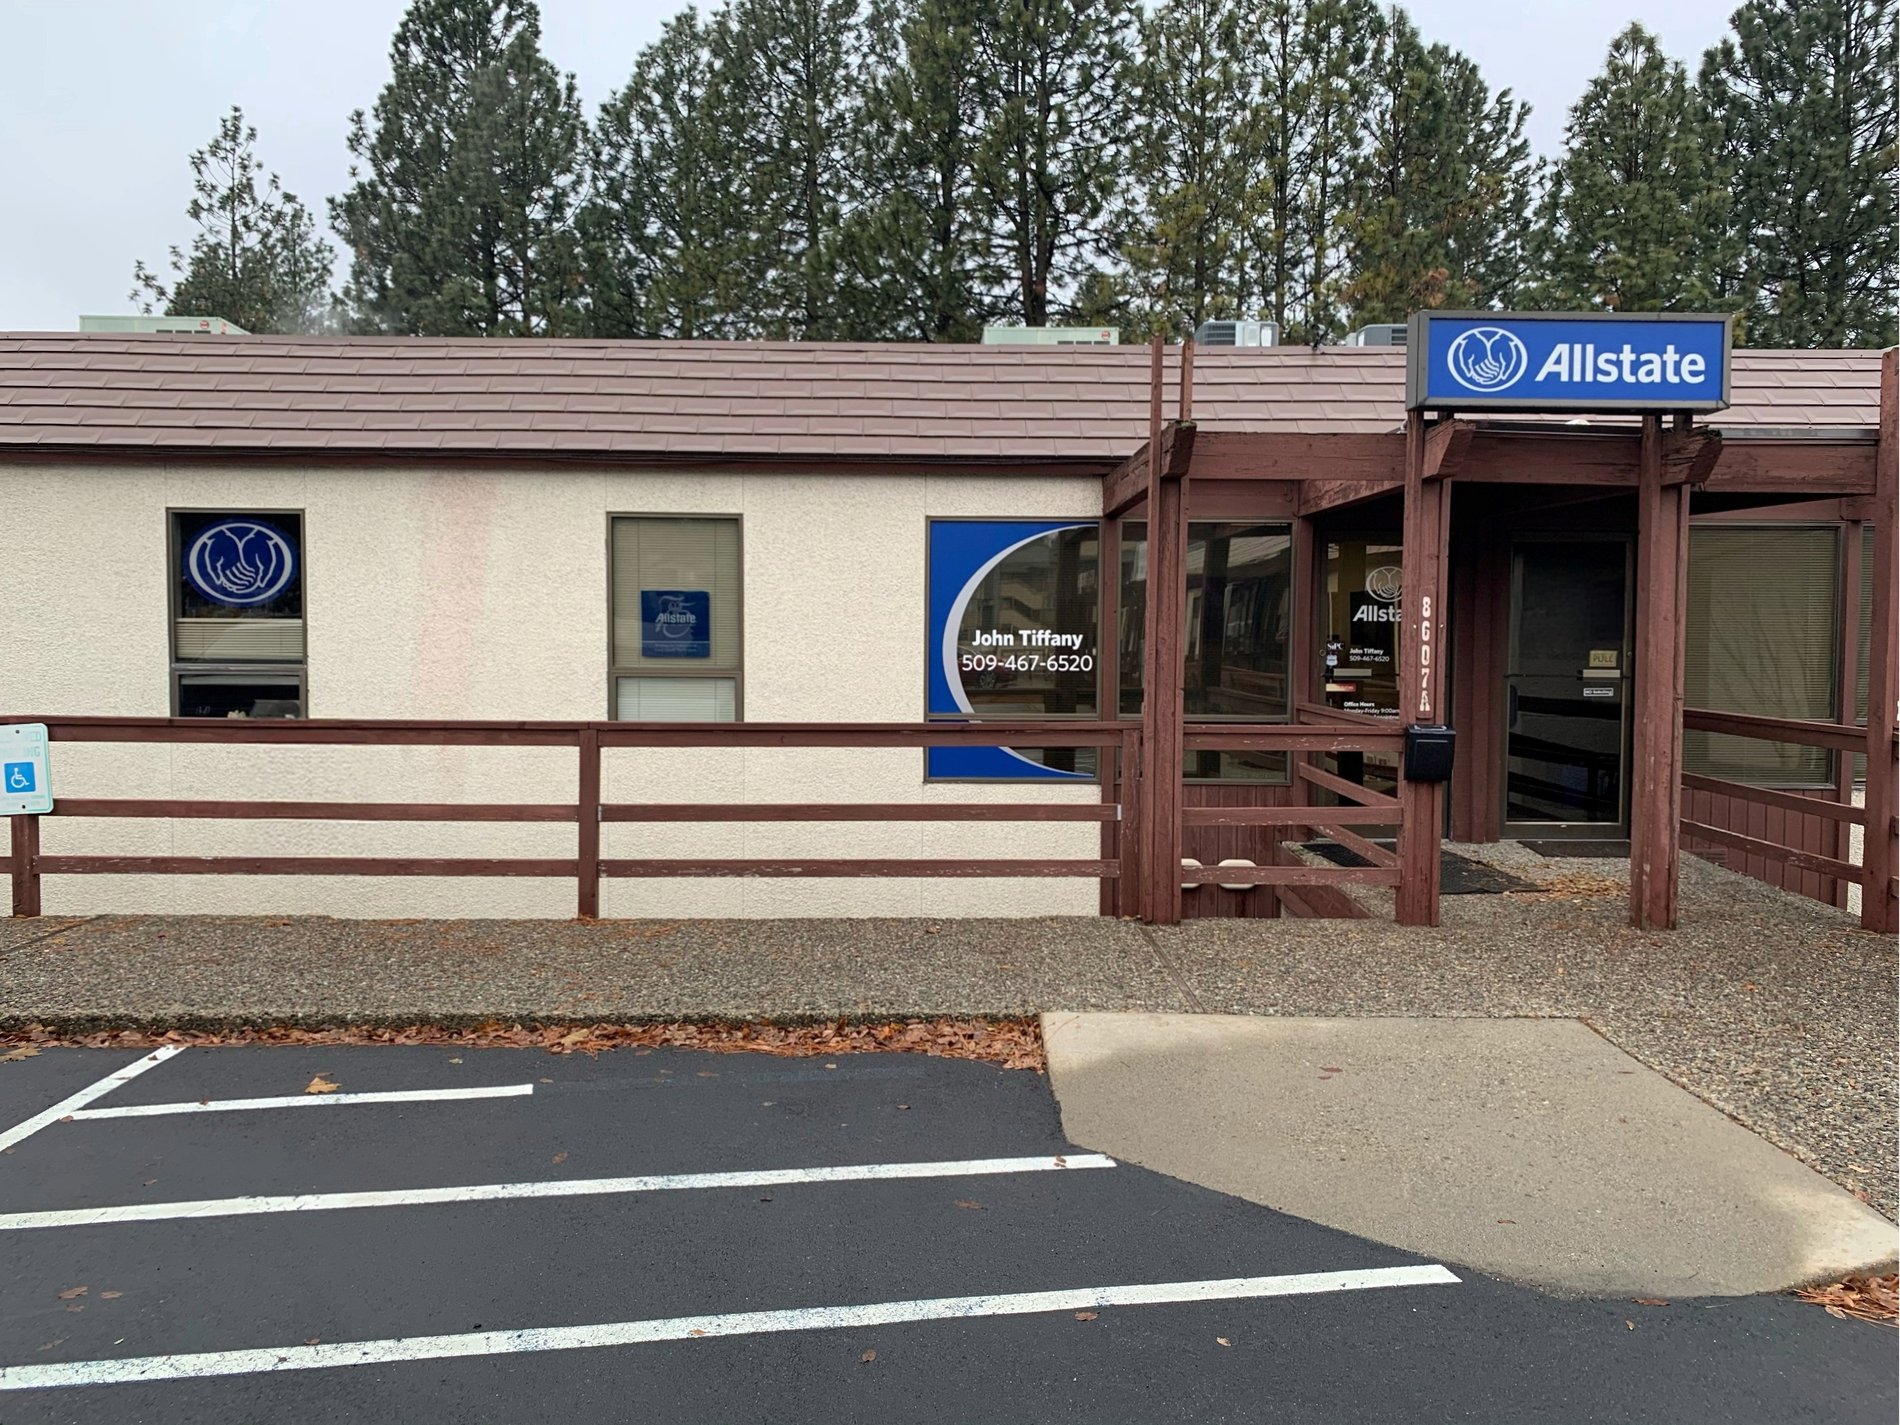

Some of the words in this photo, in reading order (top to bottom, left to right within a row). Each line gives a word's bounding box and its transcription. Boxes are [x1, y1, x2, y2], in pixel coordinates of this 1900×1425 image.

[1535, 343, 1706, 384] Allstate
[655, 612, 697, 624] Allstate
[1352, 604, 1402, 622] Allsta
[972, 629, 1015, 647] John
[1019, 629, 1084, 650] Tiffany
[1364, 647, 1384, 655] Tiffany
[1592, 653, 1614, 663] PULL
[962, 654, 1093, 671] 509-467-6520
